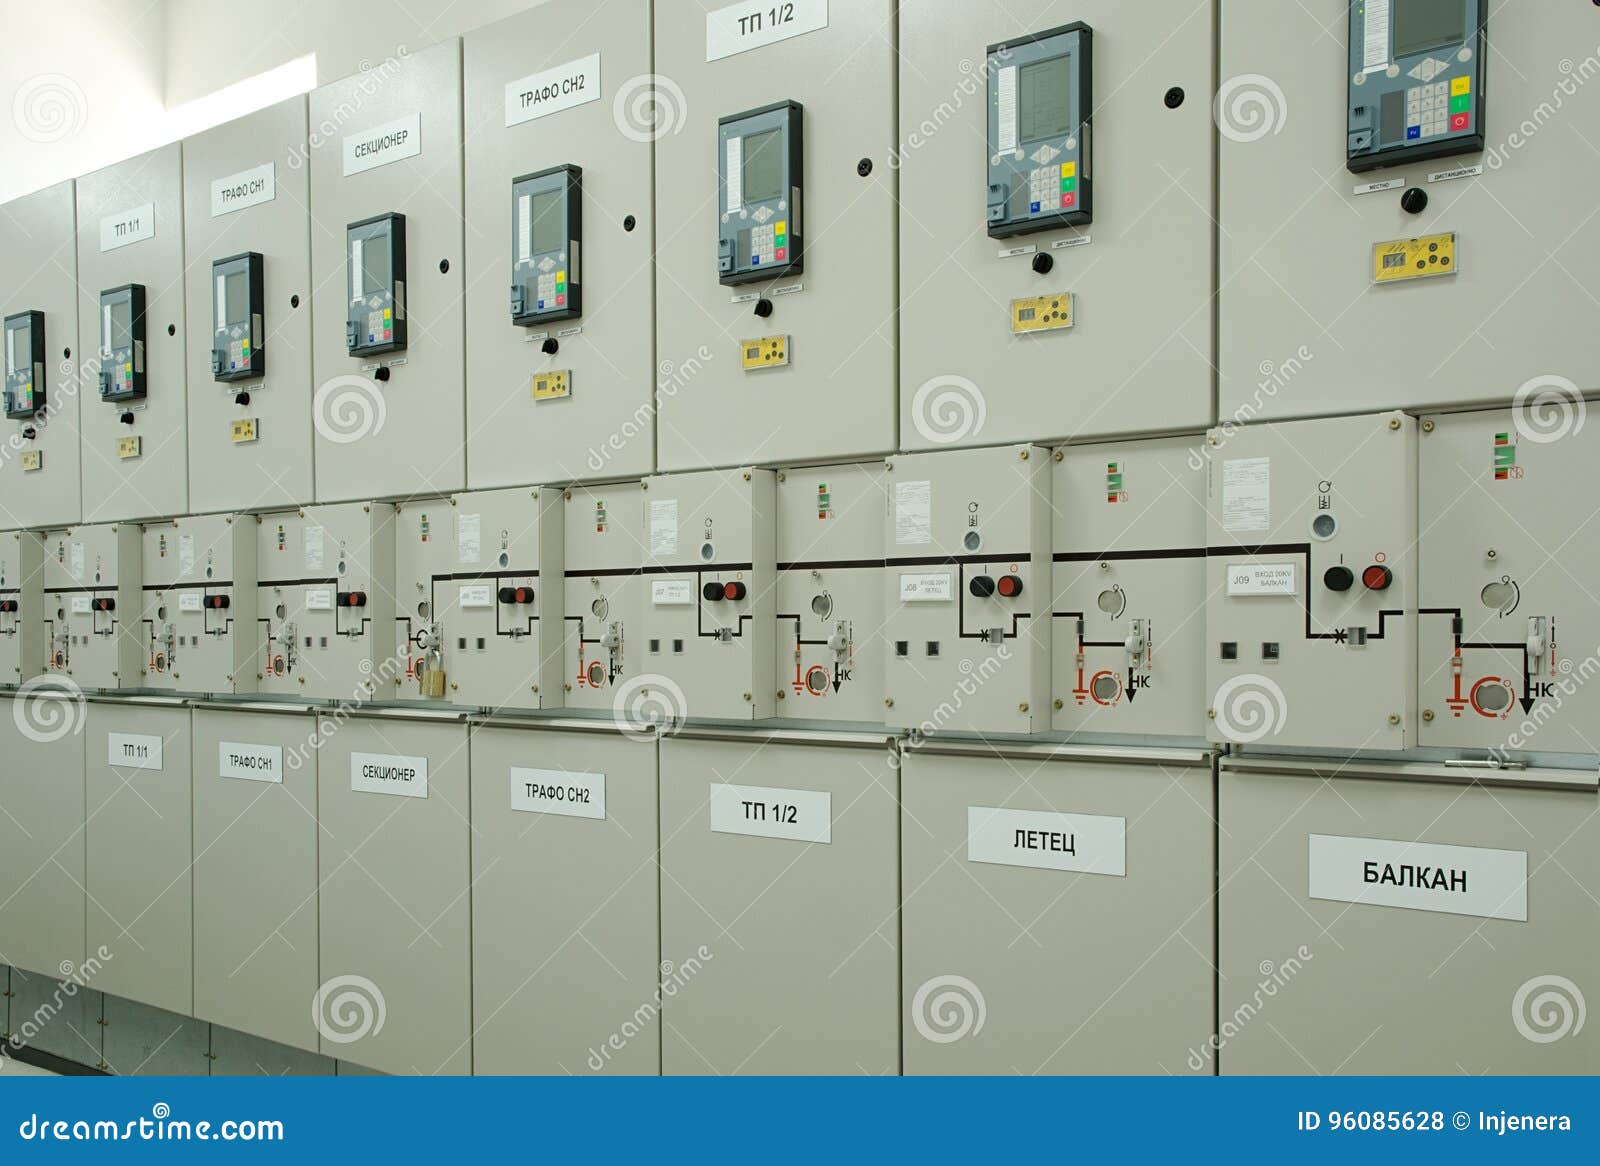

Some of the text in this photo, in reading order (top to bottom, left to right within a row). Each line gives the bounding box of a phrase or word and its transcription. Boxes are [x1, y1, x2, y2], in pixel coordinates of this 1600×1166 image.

[738, 3, 794, 36] ТП 1/2
[519, 82, 559, 108] ТРАФО
[354, 130, 409, 158] СЕКЦИОНЕР
[221, 184, 248, 203] ТРАФО
[114, 218, 140, 237] ТП 1/1
[123, 743, 148, 758] ТП 1/1
[229, 754, 256, 769] ТРАФО
[362, 765, 416, 782] СЕКЦИОНЕР
[525, 783, 564, 801] ТРАФО
[741, 801, 797, 824] ТП 1/2
[1013, 829, 1076, 857] ЛЕТЕЦ
[1363, 861, 1467, 893] БАЛКАН
